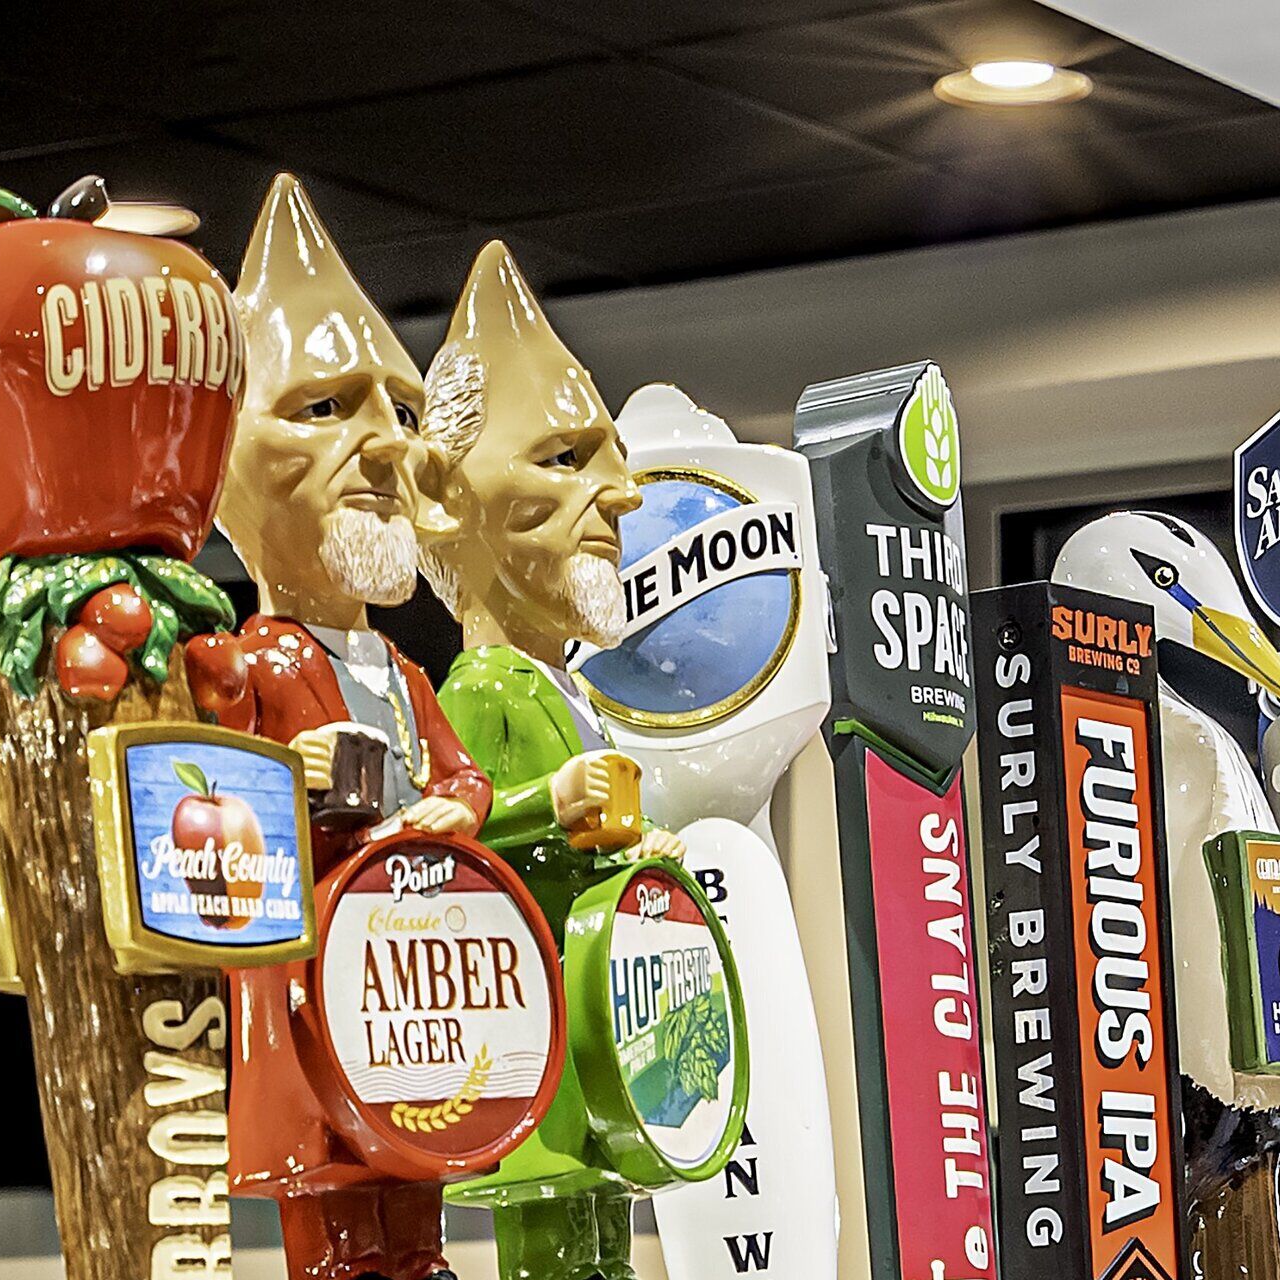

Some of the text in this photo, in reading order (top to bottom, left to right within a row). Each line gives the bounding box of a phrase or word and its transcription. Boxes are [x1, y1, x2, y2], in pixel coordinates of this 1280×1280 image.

[667, 511, 797, 597] MOON
[865, 523, 964, 597] THIRD
[870, 589, 970, 688] SPACE
[1051, 605, 1152, 657] SURLY
[1068, 644, 1124, 672] BREWING
[910, 685, 966, 714] BREWING
[995, 654, 1043, 874] SURLY
[142, 837, 297, 898] Peach County
[385, 853, 456, 903] Point
[635, 883, 671, 926] Point
[368, 903, 442, 936] Classic
[920, 812, 972, 1041] CLANS
[360, 937, 527, 1013] AMBER
[1077, 717, 1161, 1224] FURIOUS IPA
[364, 1017, 467, 1069] LAGER
[1008, 908, 1064, 1248] BREWING
[938, 1072, 984, 1198] THE
